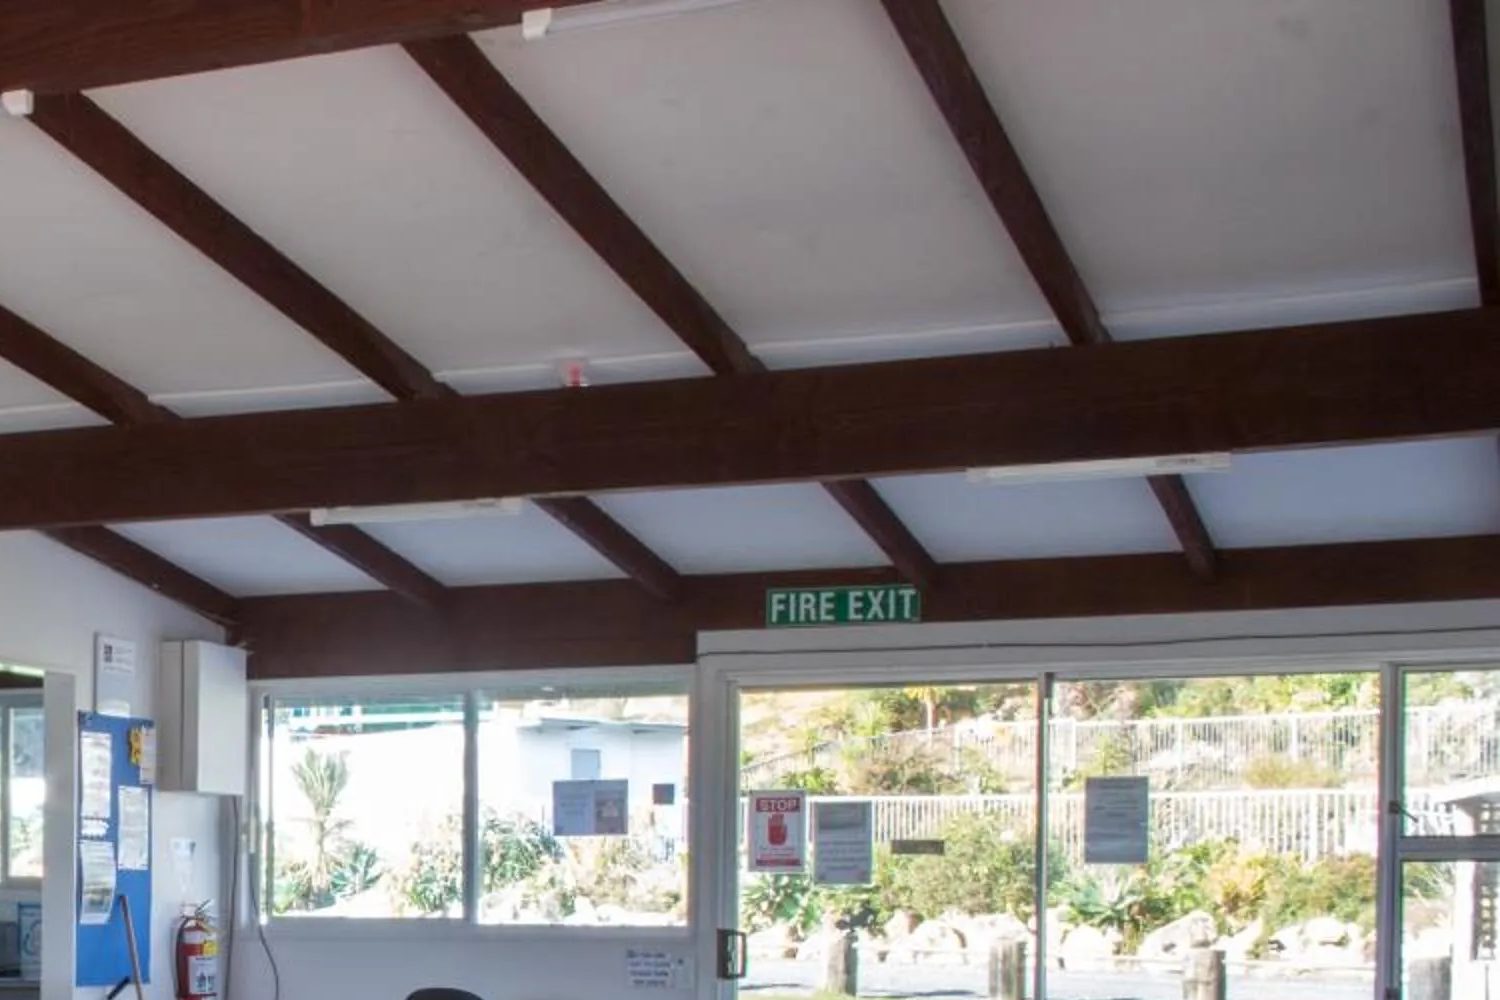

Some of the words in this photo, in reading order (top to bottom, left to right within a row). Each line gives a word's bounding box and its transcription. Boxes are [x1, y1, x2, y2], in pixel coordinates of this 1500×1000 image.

[771, 591, 836, 623] FIRE
[848, 588, 916, 620] EXIT
[759, 799, 798, 811] STOP
